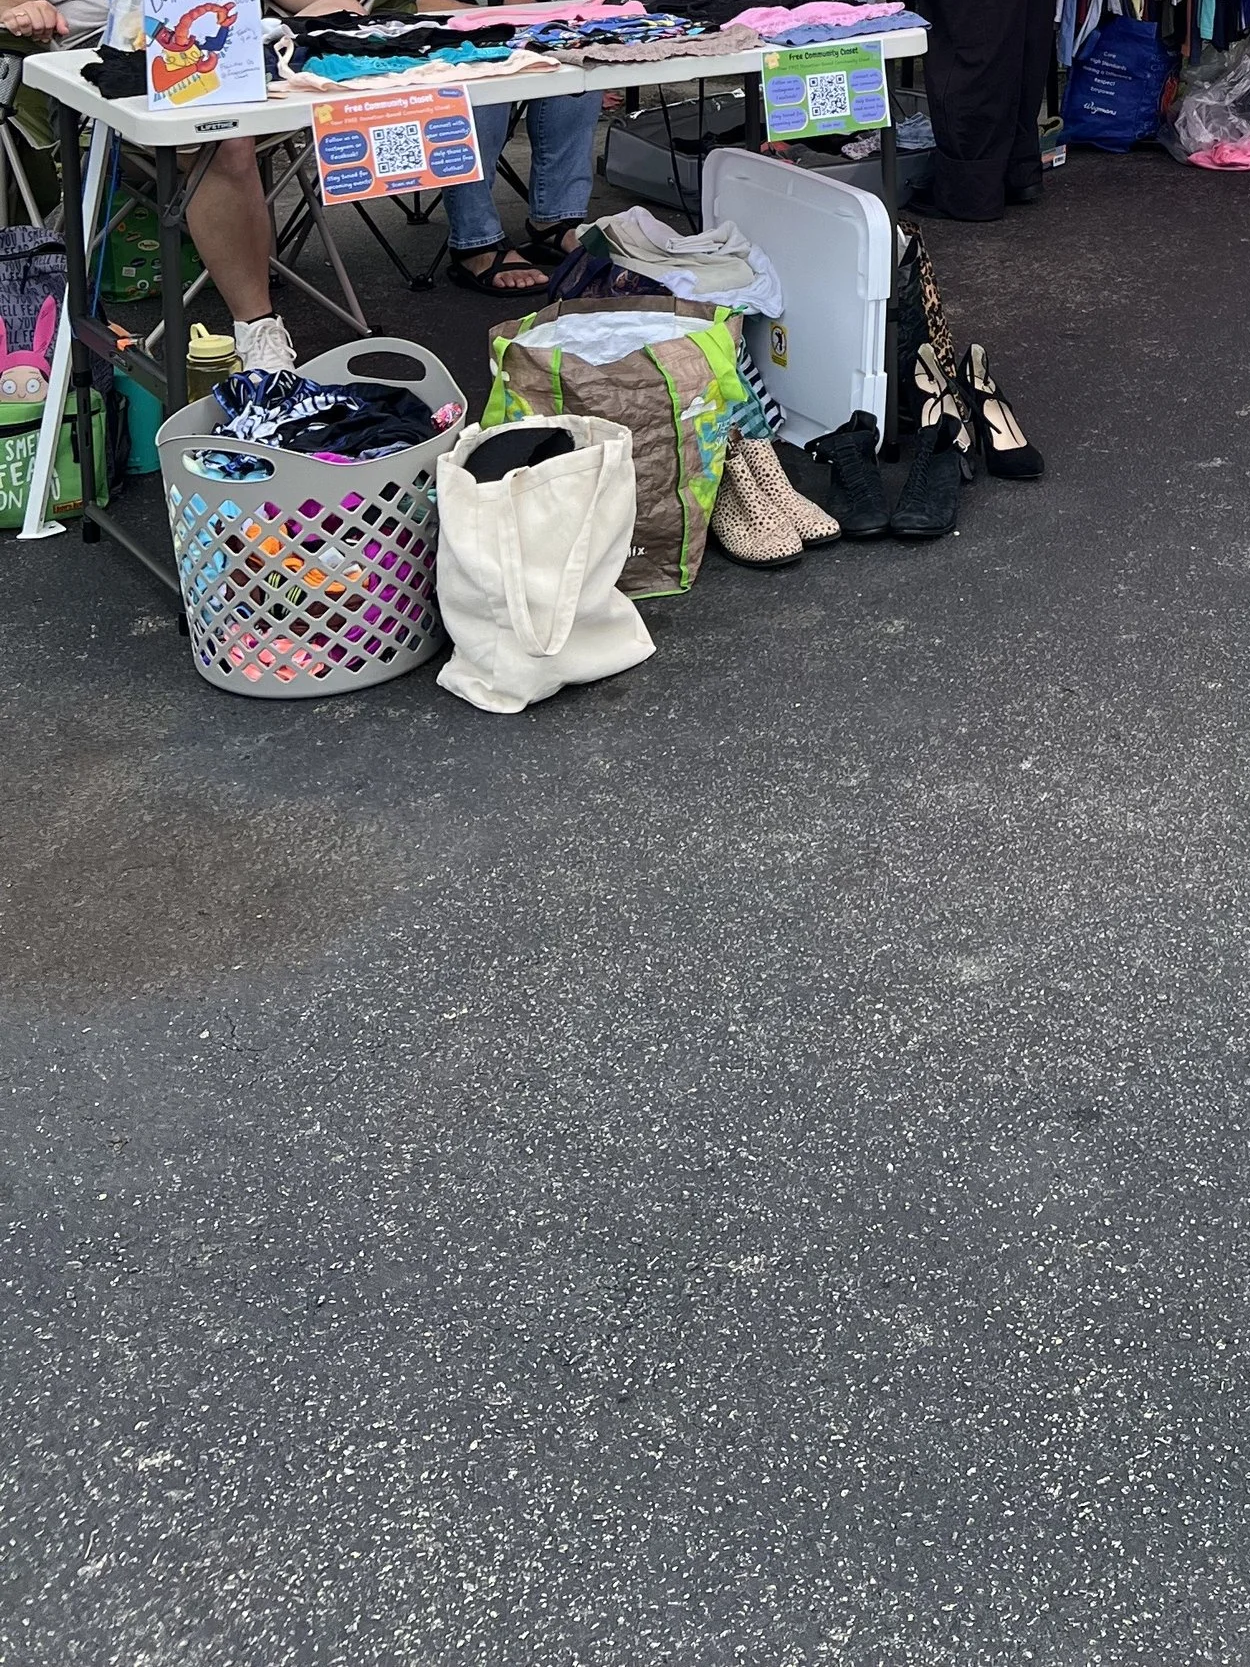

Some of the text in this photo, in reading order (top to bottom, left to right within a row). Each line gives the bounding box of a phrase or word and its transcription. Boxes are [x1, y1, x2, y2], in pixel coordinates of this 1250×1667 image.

[788, 52, 804, 61] Free
[344, 94, 434, 114] Free Community Closet
[5, 434, 41, 462] SME
